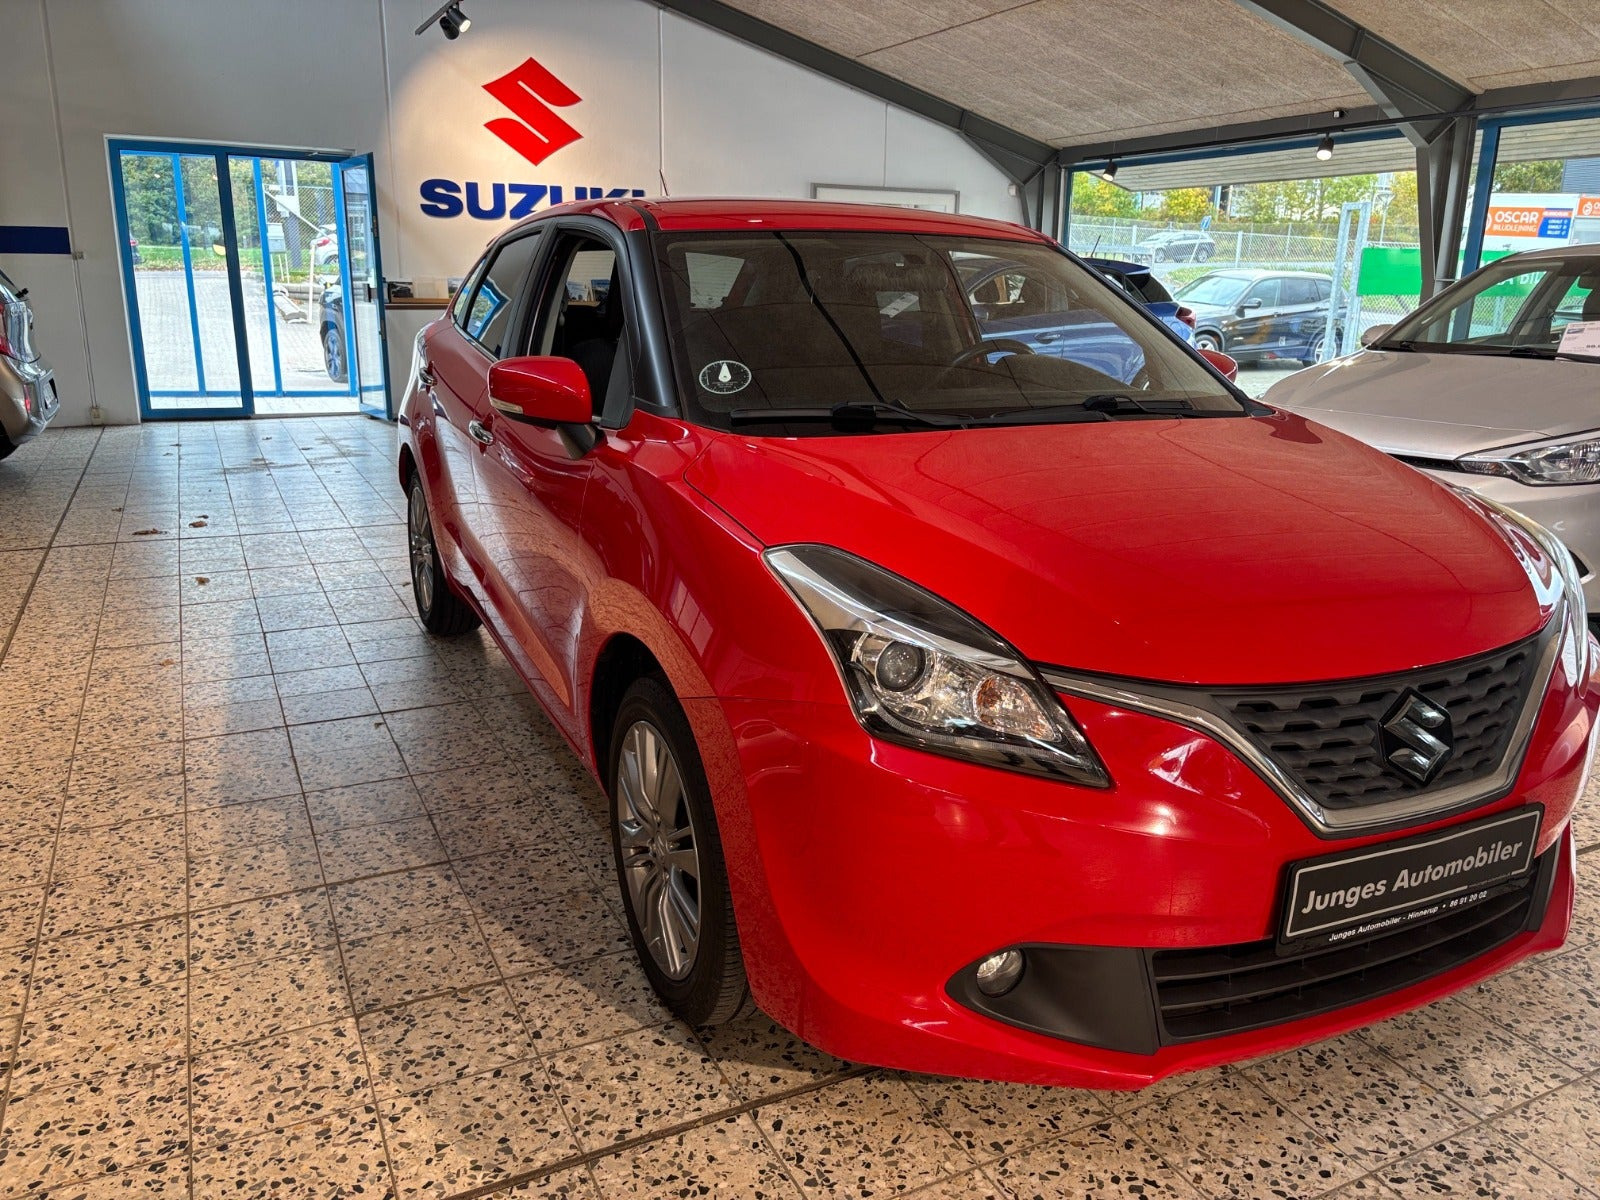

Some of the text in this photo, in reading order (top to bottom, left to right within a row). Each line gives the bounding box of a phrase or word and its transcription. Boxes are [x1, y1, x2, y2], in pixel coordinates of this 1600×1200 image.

[420, 179, 645, 219] SUZ
[1495, 211, 1539, 223] OSCAR
[1302, 880, 1386, 913] Junges
[1392, 841, 1522, 892] Automobiler
[1329, 929, 1356, 941] Junges
[1357, 918, 1402, 933] Automobiler
[1407, 907, 1438, 920] Hinnerup
